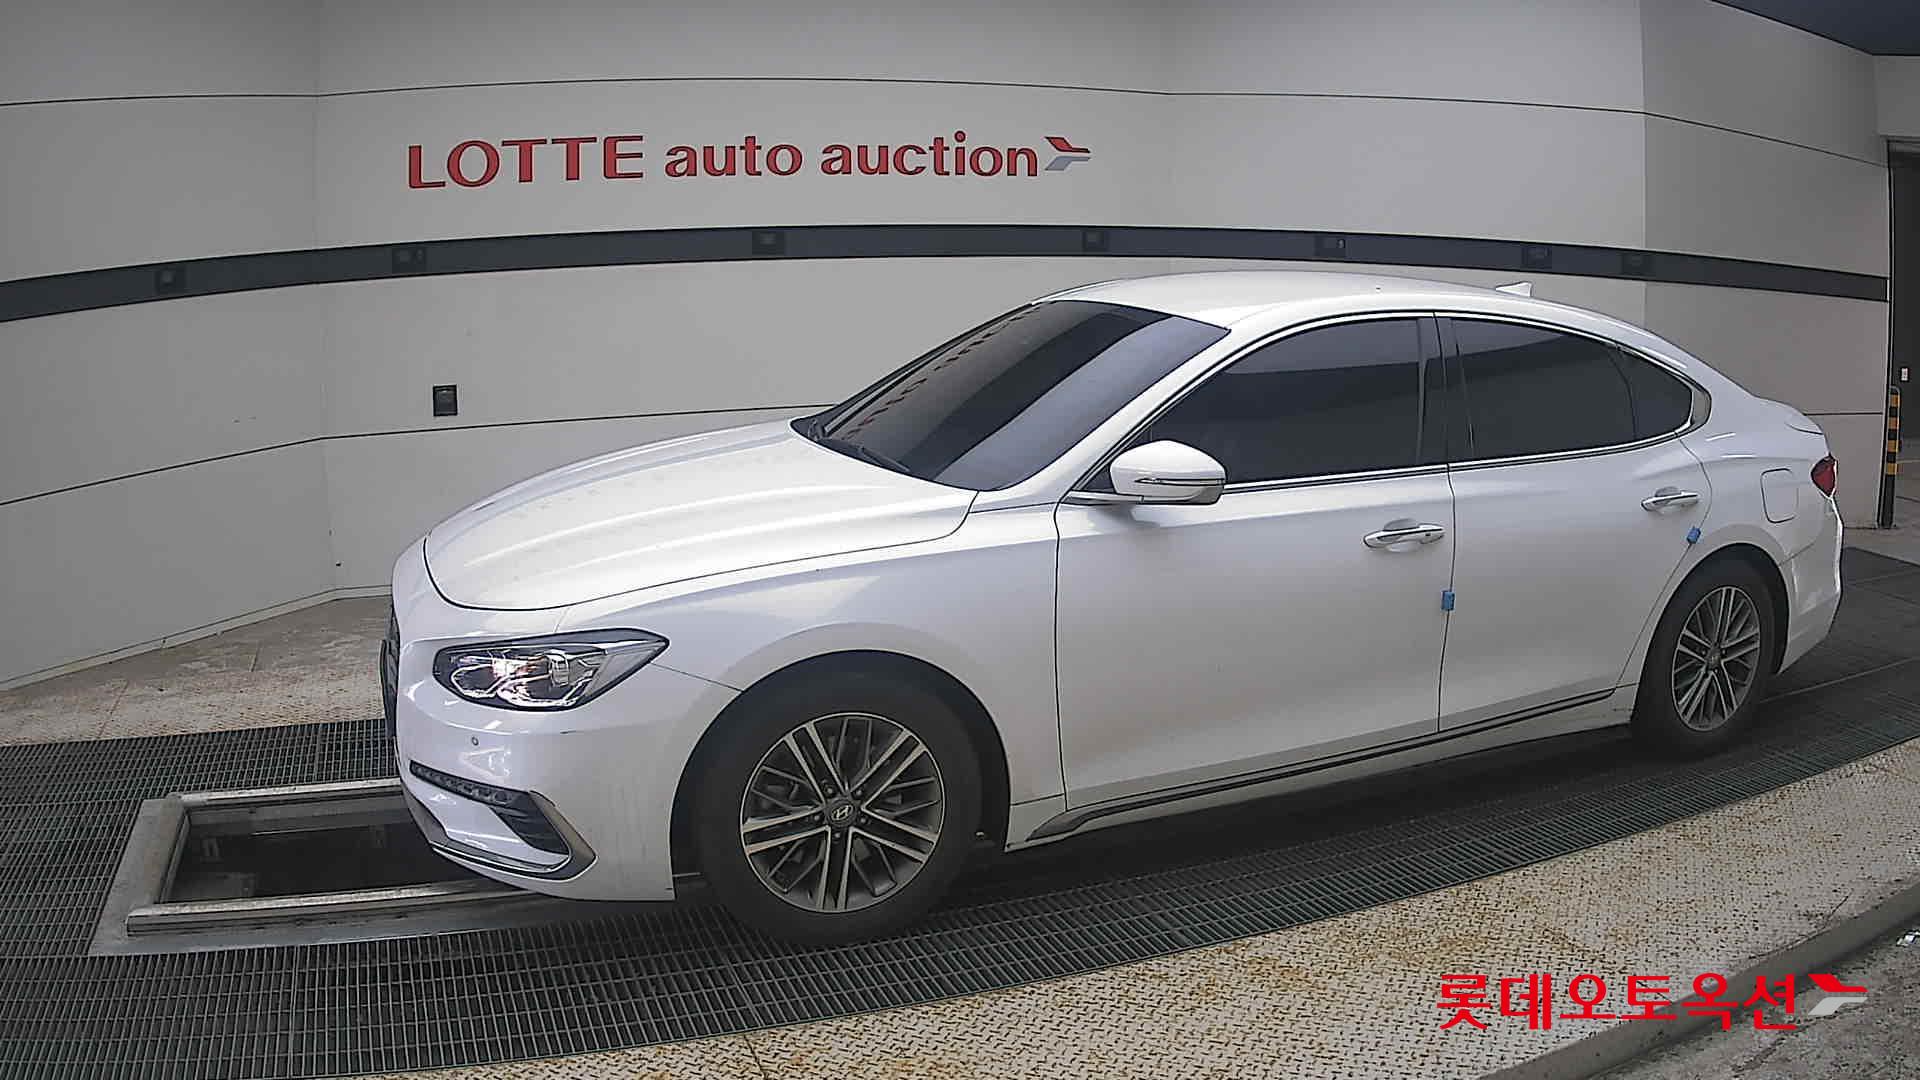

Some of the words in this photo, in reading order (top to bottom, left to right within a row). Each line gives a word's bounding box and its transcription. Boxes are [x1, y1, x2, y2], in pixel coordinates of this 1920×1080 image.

[408, 135, 644, 189] LOTTE
[664, 135, 803, 177] auto
[821, 131, 1039, 177] auction
